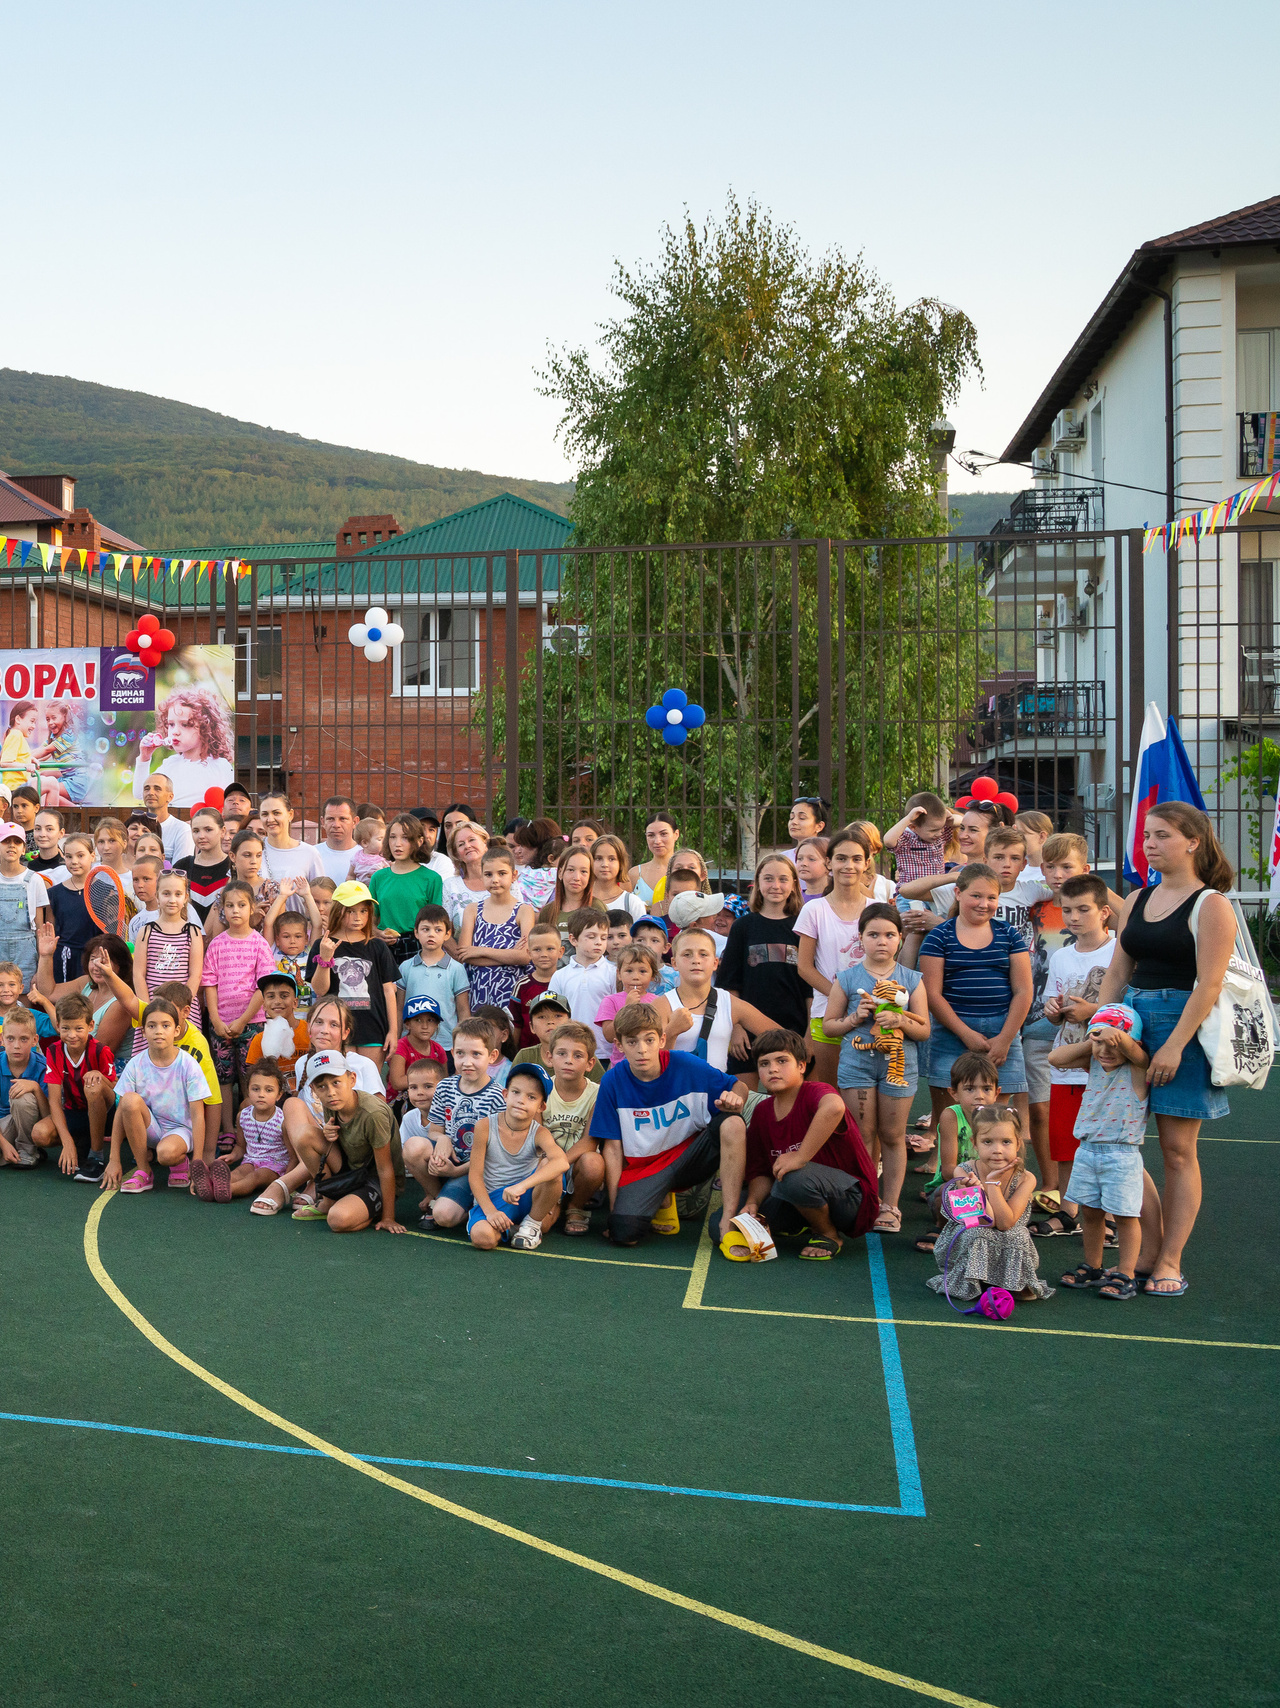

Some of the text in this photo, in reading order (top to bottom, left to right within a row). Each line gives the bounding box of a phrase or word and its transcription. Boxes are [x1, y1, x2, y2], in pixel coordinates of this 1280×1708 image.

[111, 690, 145, 698] ЕДИНАЯ
[547, 1114, 587, 1126] AMPIONS
[634, 1100, 691, 1131] FILA
